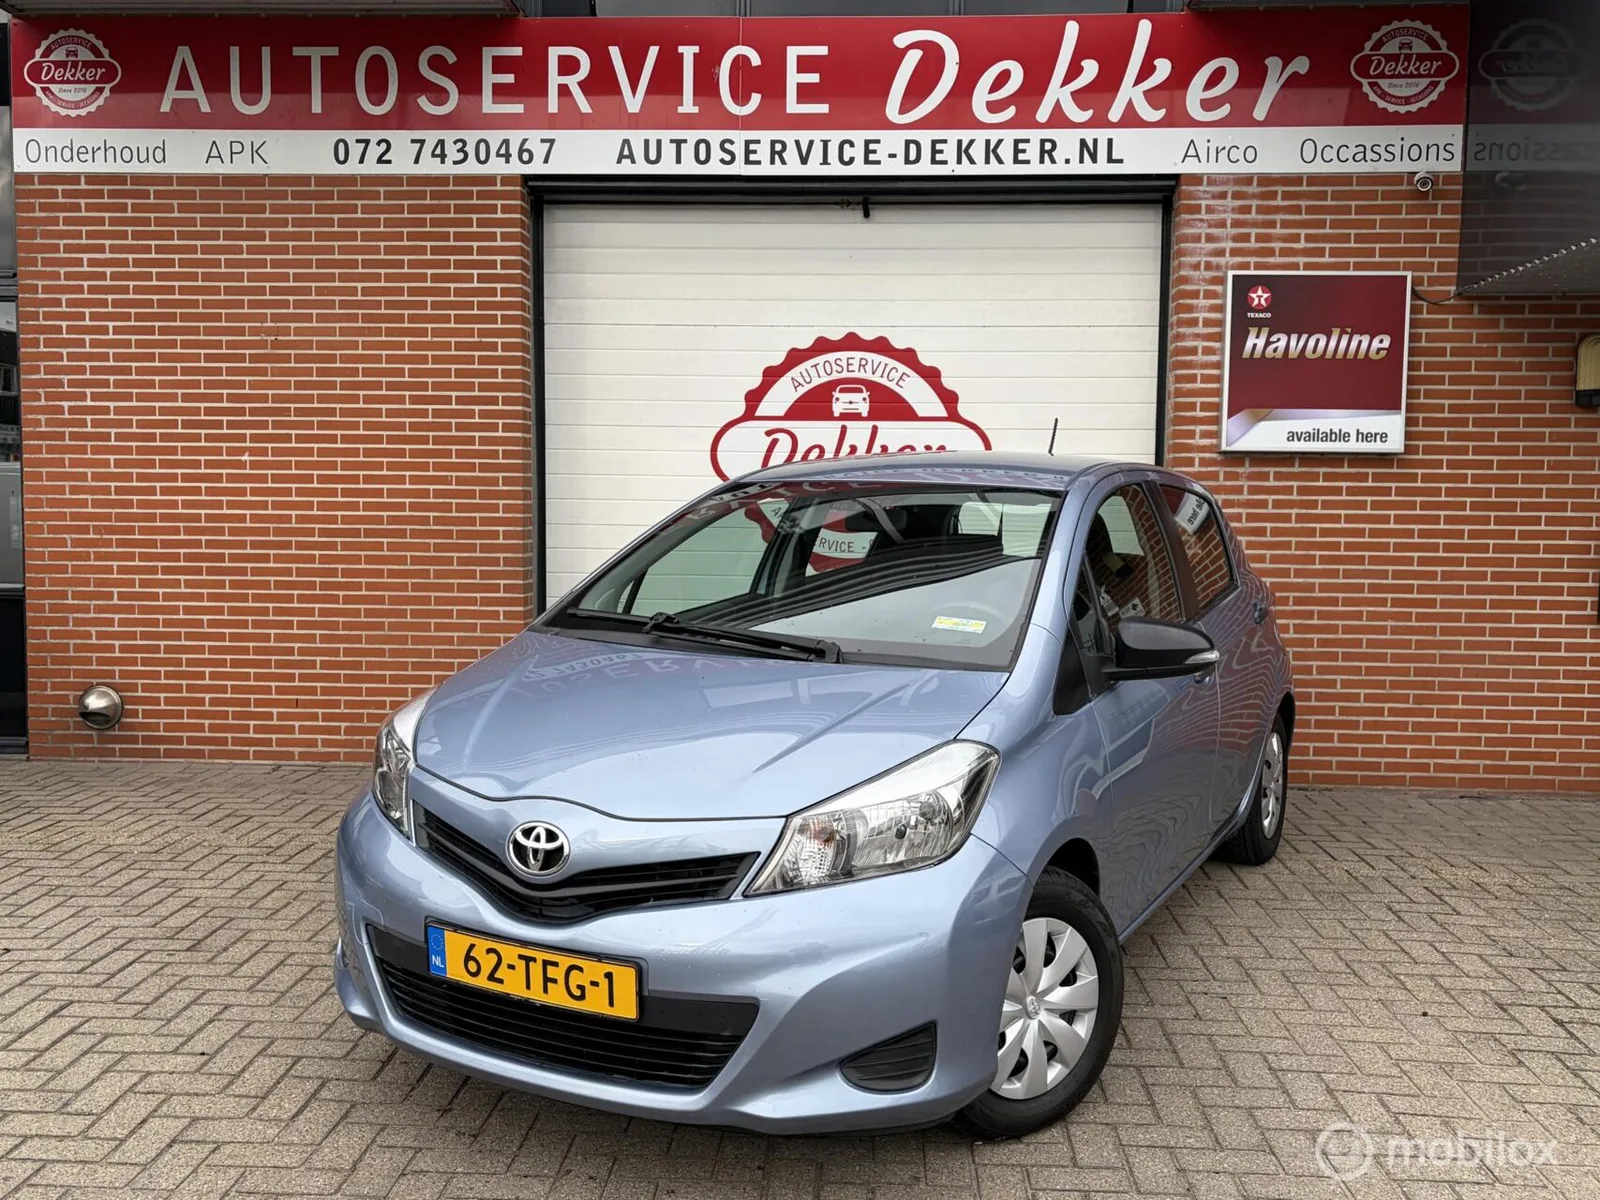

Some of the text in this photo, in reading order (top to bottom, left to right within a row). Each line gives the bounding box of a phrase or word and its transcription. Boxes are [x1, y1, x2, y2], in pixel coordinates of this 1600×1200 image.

[50, 36, 92, 50] AUTOSERVICE
[1381, 28, 1430, 43] AUTOSERVICE
[40, 60, 105, 81] Dekker
[159, 18, 1311, 125] AUTOSERVICE Dekker
[1369, 53, 1442, 76] Dekker
[24, 136, 1456, 166] Onderhoud APK 072 7430467 AUTOSERVICE-DEKKER.NL Airco Occassions
[1246, 311, 1272, 319] TEXACO
[1241, 326, 1392, 361] Havoline
[790, 356, 911, 393] AUTOSERVICE
[1286, 428, 1389, 444] available here
[431, 954, 445, 968] NL
[463, 942, 616, 1008] 62-TFG-1
